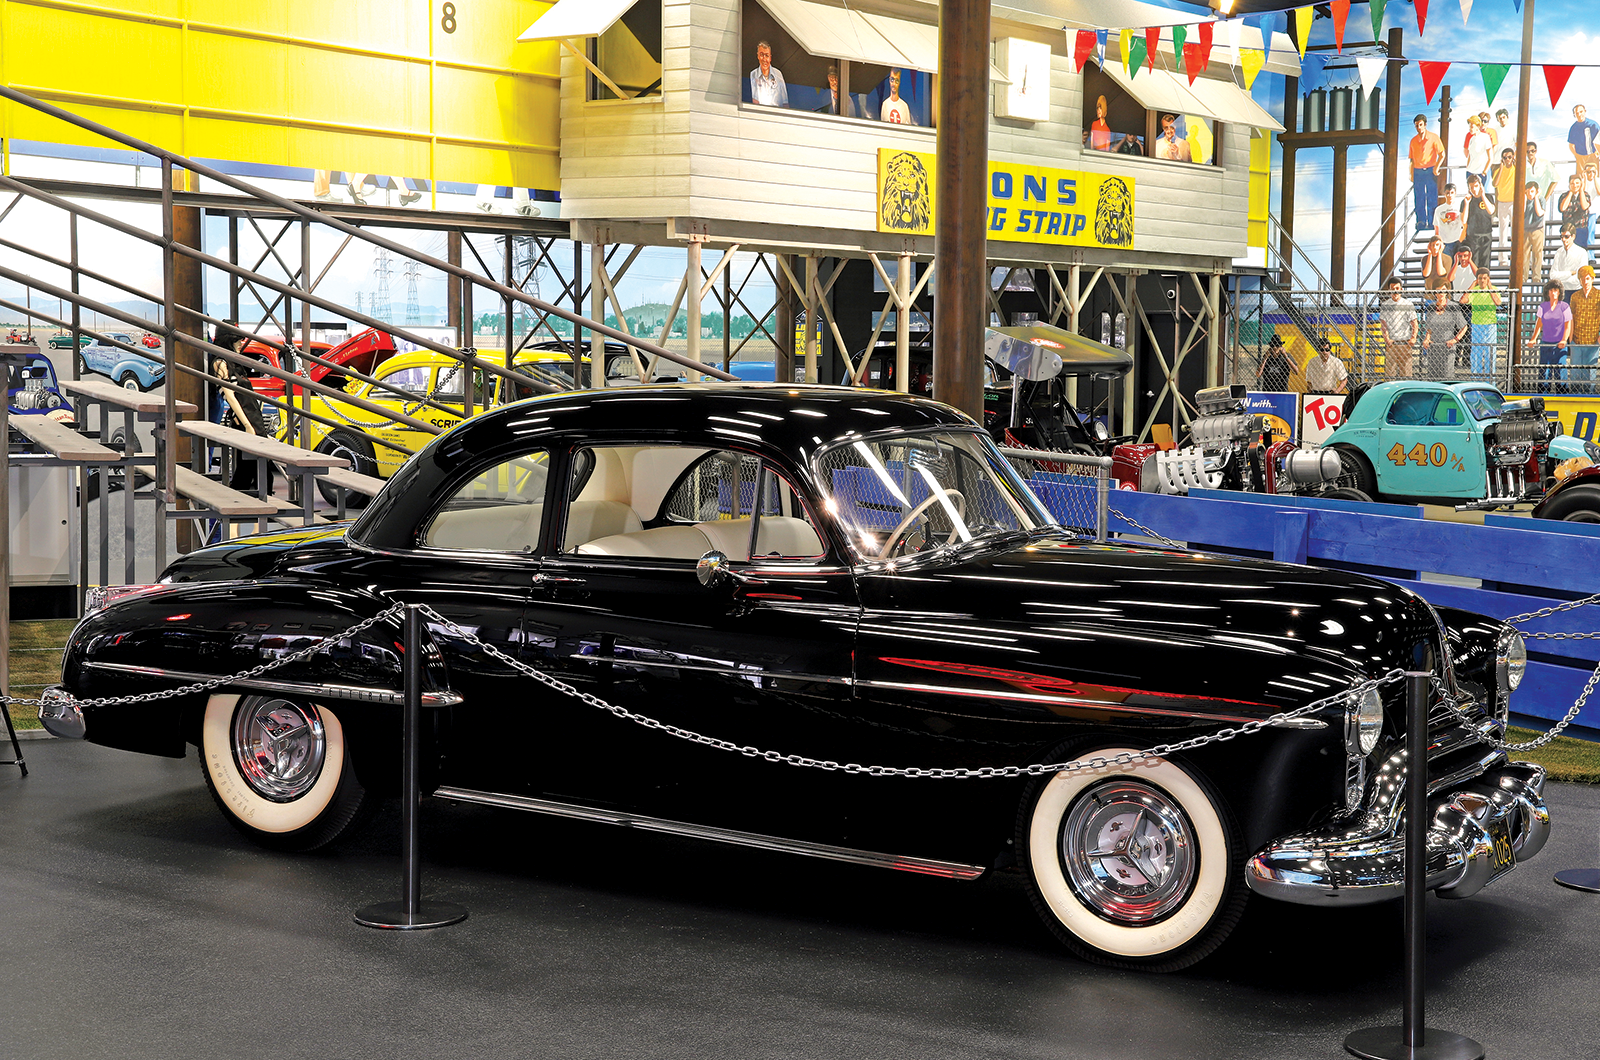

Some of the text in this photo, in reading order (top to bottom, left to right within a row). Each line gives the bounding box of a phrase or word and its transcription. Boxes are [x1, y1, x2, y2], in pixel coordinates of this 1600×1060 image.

[441, 2, 457, 34] 8
[991, 171, 1077, 206] ONS
[1014, 208, 1087, 237] STRIP
[1304, 397, 1344, 431] To
[1386, 442, 1448, 467] 440
